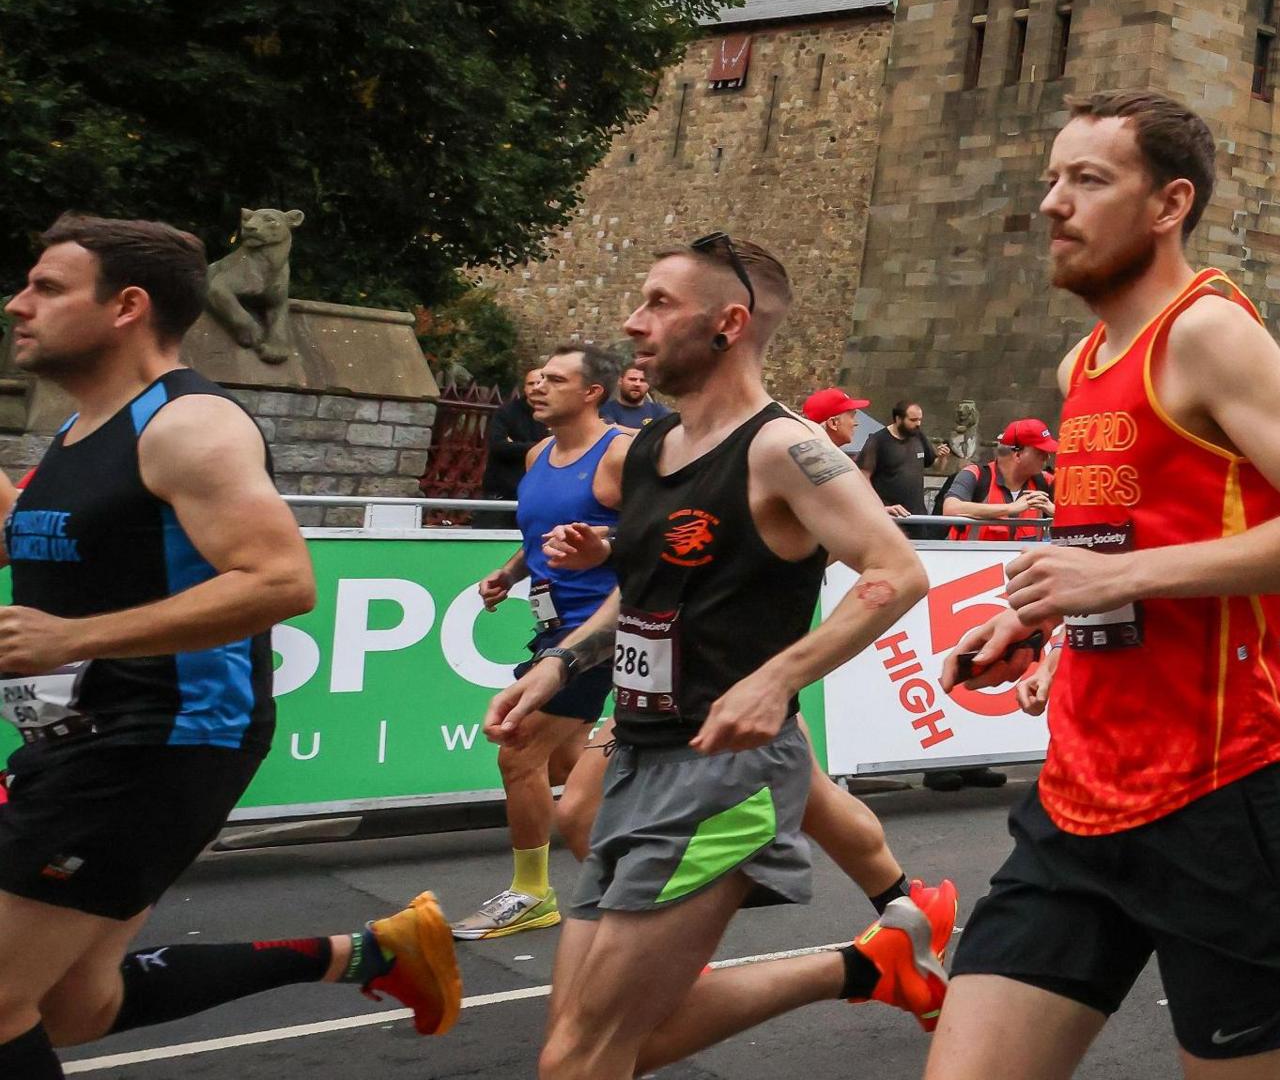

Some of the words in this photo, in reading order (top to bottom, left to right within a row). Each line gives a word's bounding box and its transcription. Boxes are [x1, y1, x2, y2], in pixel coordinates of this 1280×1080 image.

[1093, 532, 1126, 546] Society
[616, 644, 650, 678] 286
[875, 631, 953, 749] HIGH
